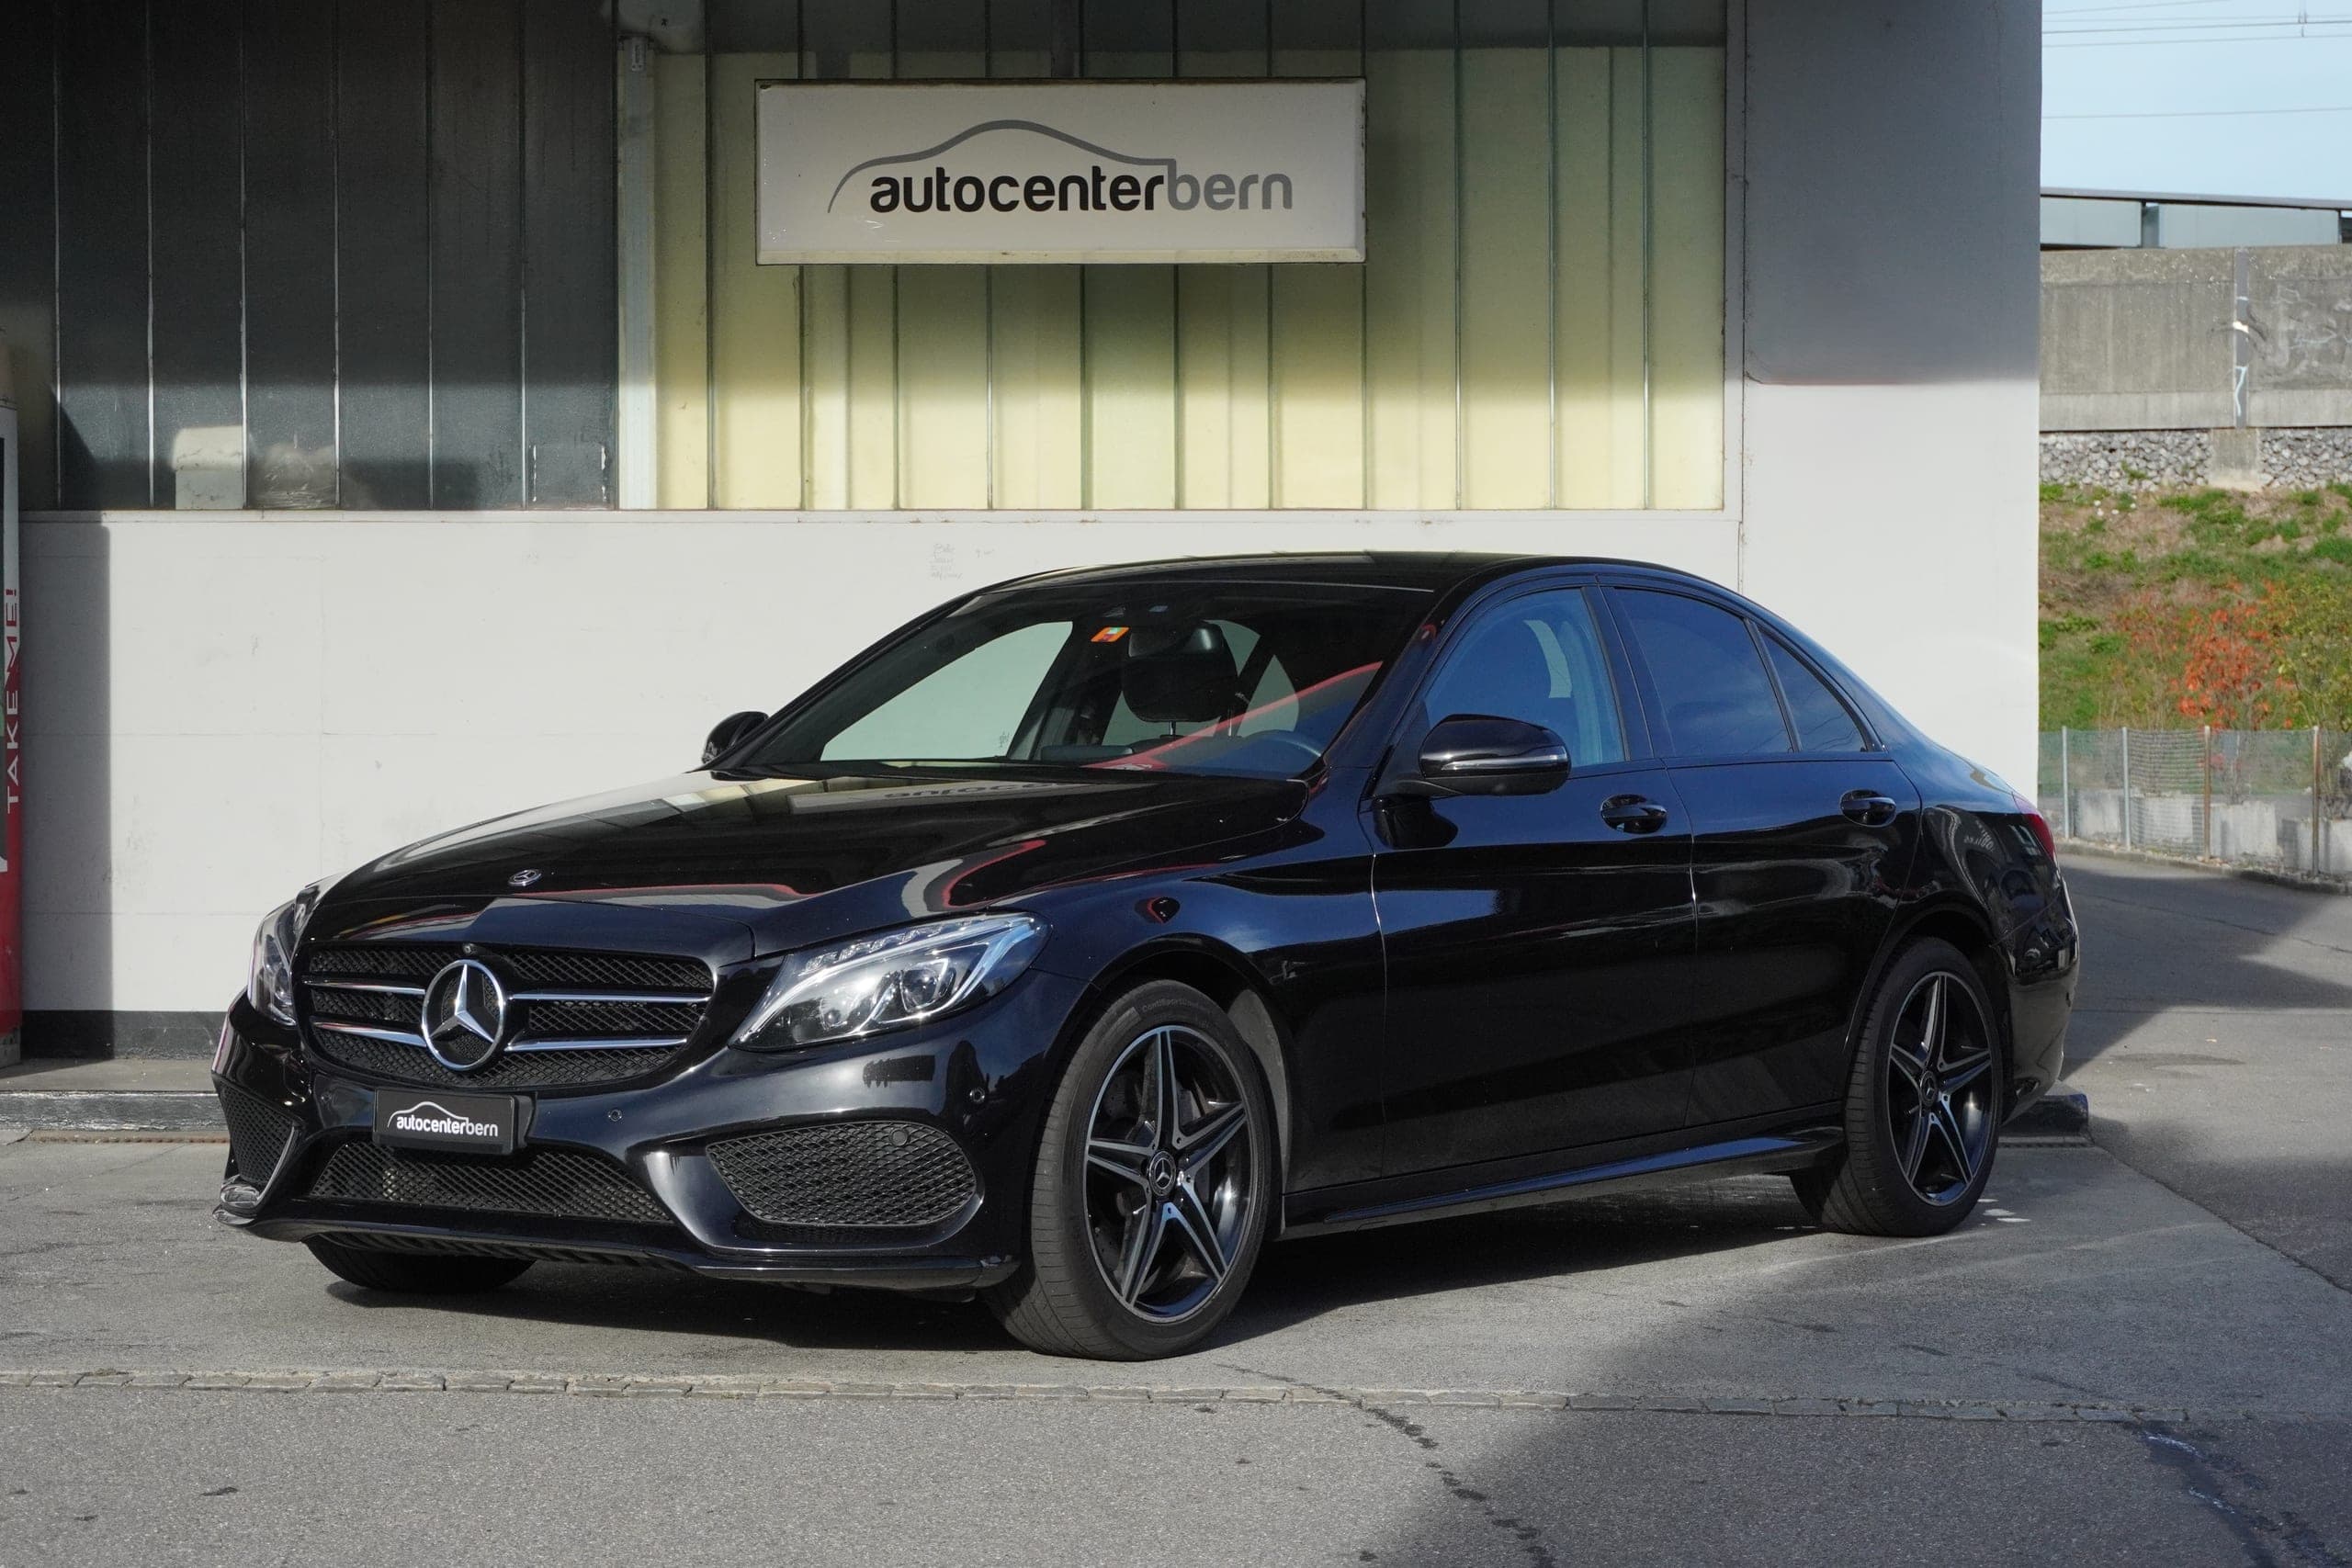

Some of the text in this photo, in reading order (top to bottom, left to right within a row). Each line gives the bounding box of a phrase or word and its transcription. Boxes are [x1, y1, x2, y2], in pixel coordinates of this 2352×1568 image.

[870, 164, 1294, 213] autocenterbern
[6, 589, 20, 813] TAKE ME!
[396, 1115, 499, 1137] autocenterbern
